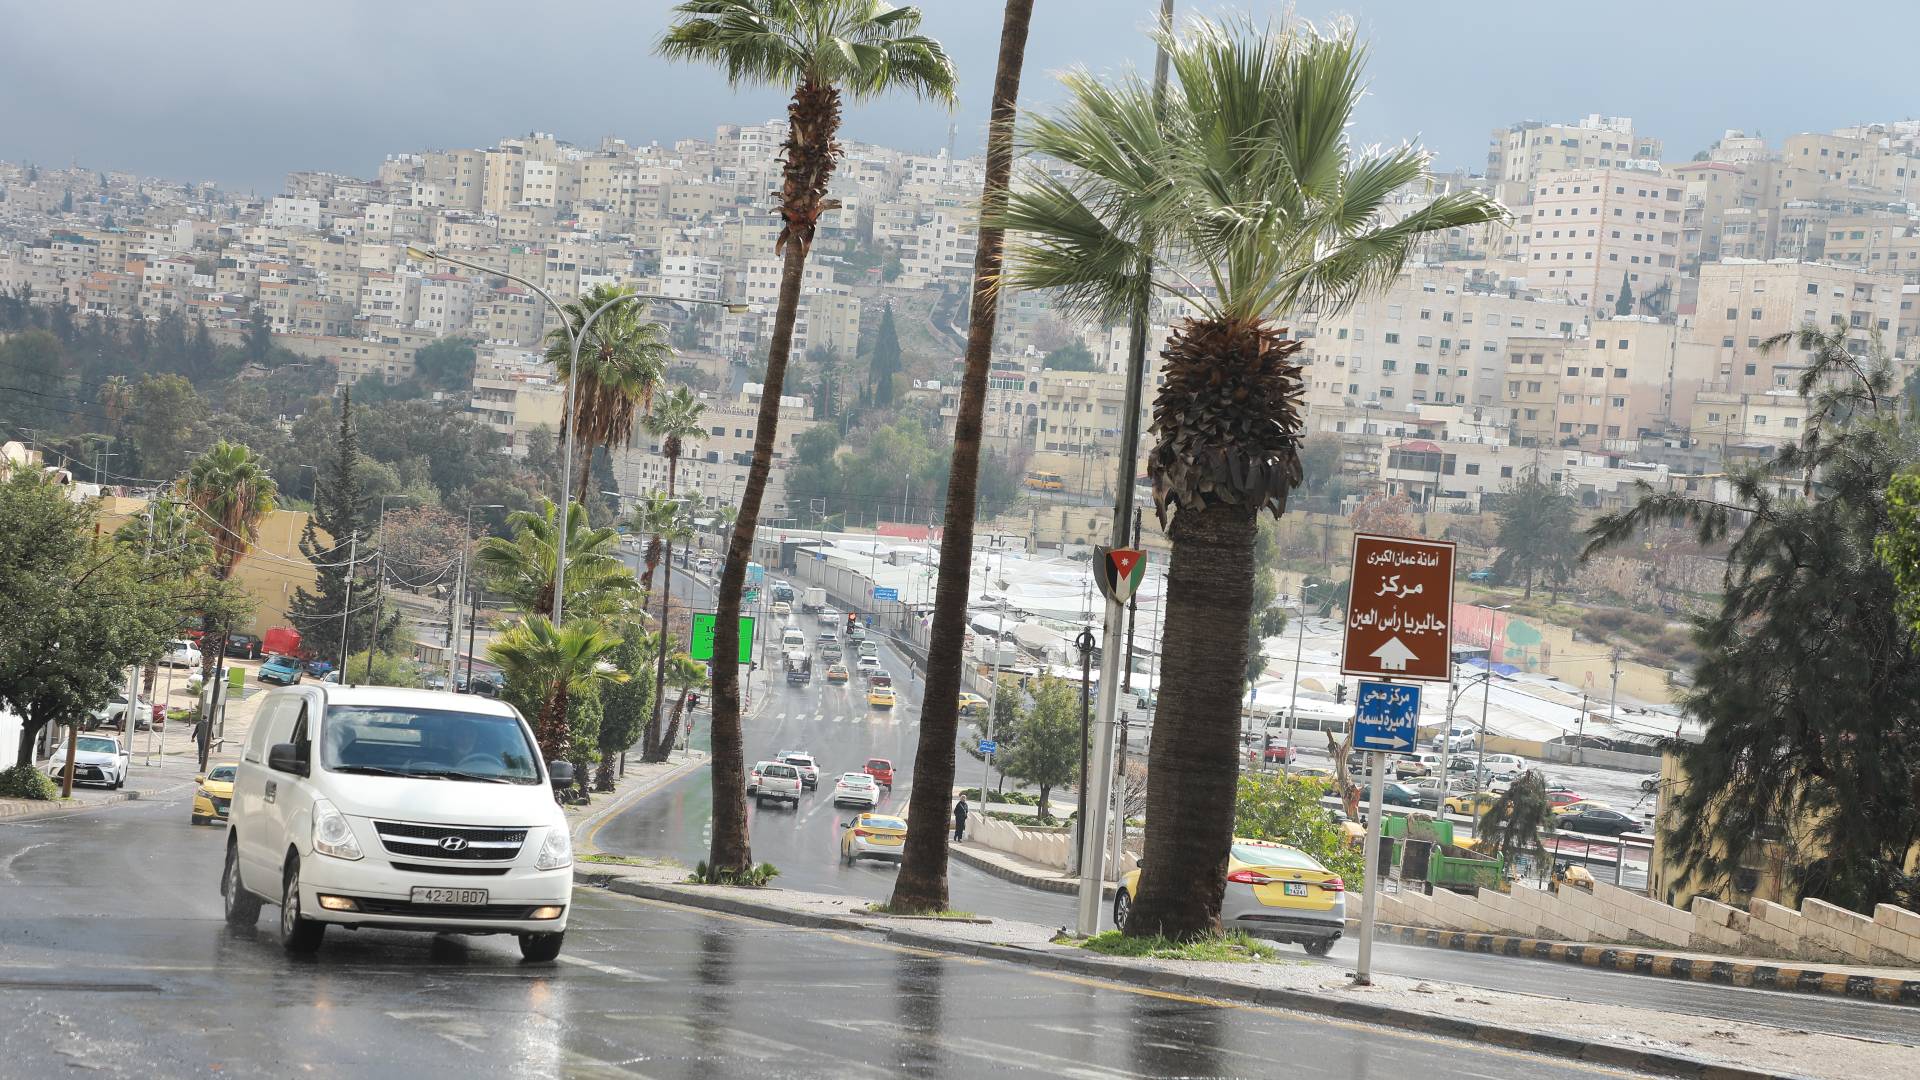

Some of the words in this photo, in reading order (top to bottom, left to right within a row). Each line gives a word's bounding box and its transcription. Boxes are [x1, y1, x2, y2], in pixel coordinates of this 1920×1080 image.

[1367, 549, 1395, 566] الكبرى
[1394, 551, 1416, 566] عمان
[1417, 551, 1439, 566] أمانة
[1375, 575, 1423, 598] مركز
[1350, 608, 1378, 630] العين
[1378, 604, 1401, 632] رأس
[1404, 611, 1446, 636] جاليريا
[1363, 690, 1387, 705] صحي
[1387, 688, 1410, 706] مركز
[1357, 705, 1384, 731] بسمة
